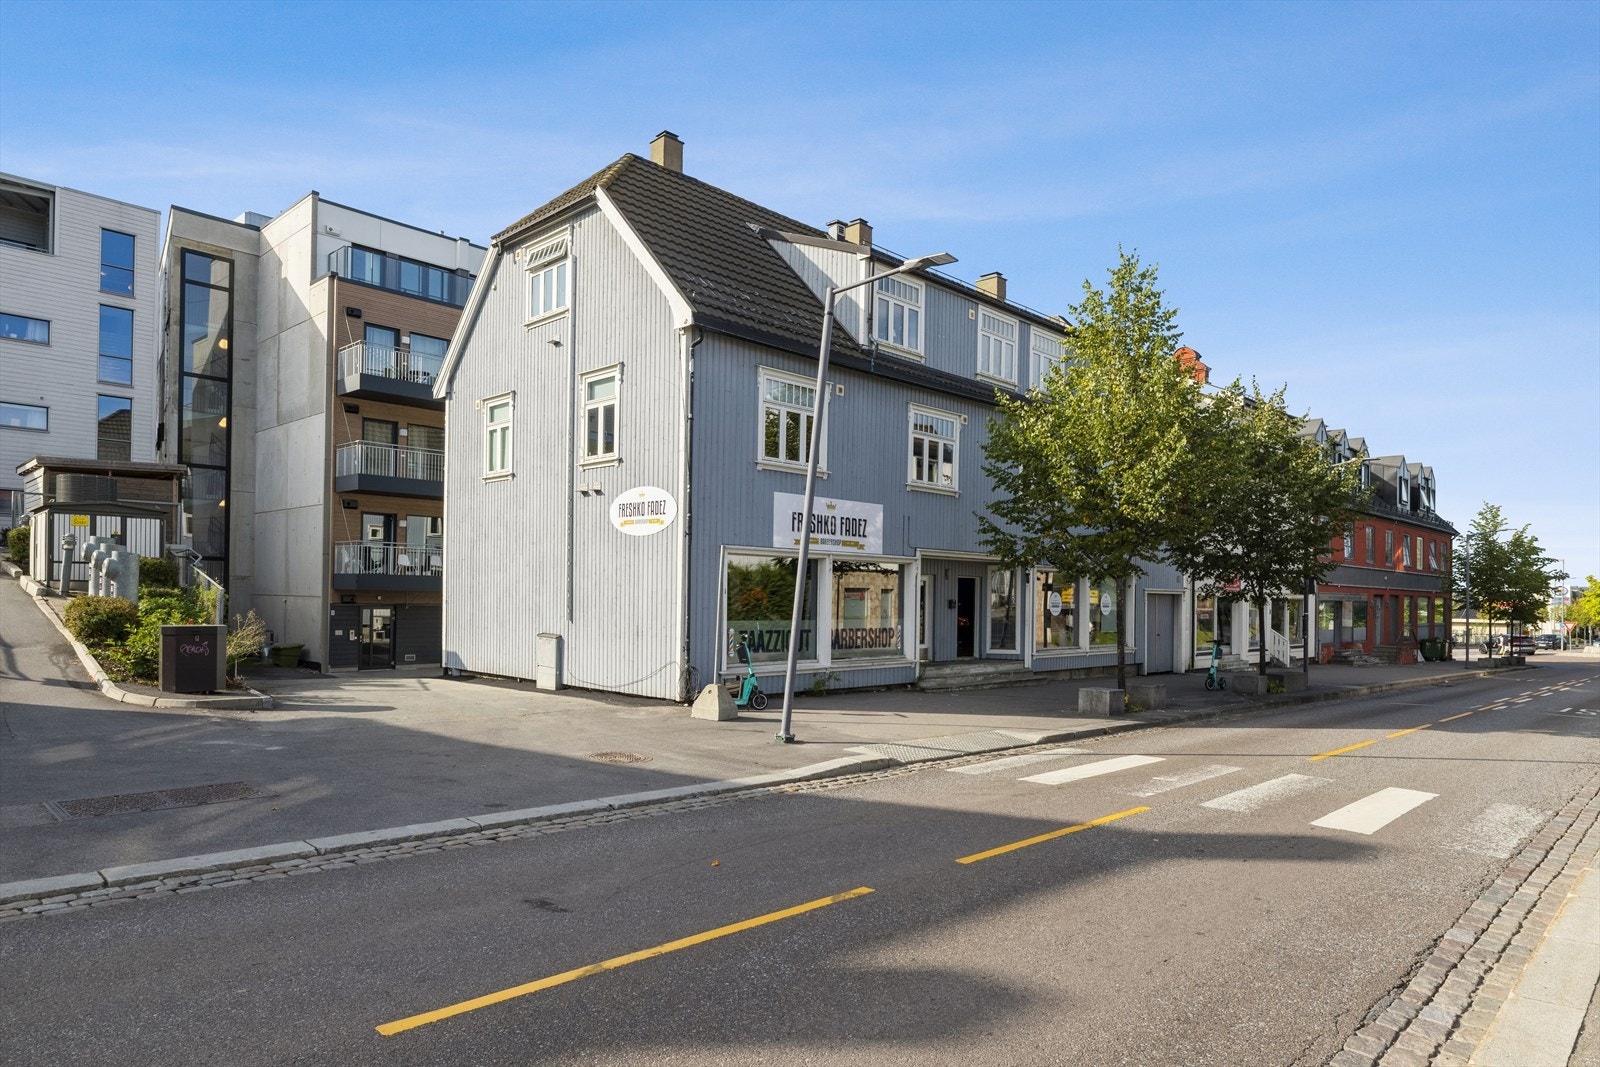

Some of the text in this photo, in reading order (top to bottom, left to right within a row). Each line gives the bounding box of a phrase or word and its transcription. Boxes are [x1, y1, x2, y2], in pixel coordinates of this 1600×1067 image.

[618, 500, 666, 518] FRESHKO FADEZ
[791, 511, 867, 538] FRSHKO FADEZ
